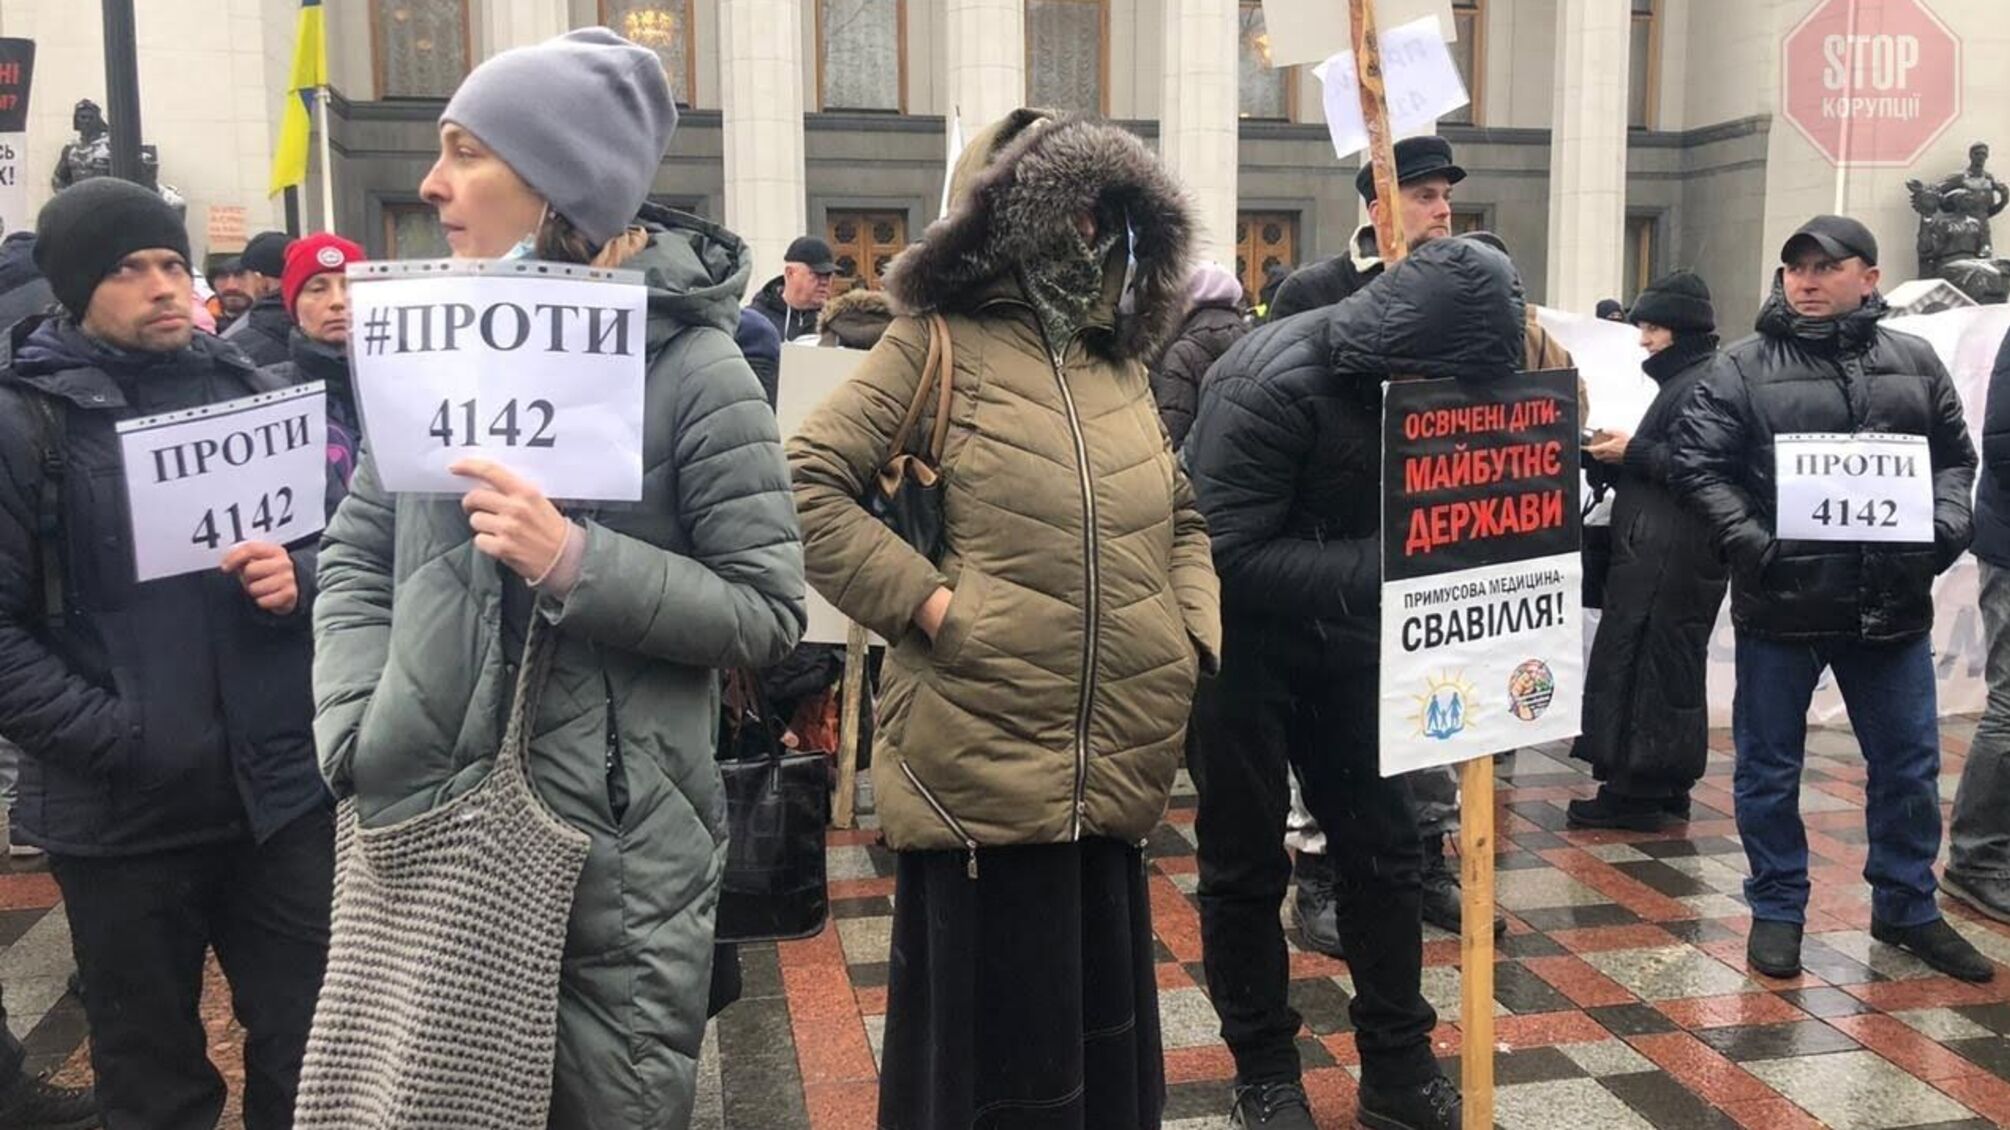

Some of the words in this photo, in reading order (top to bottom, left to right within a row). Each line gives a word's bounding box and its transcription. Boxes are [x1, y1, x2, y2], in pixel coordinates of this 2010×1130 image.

[364, 302, 636, 356] #ПРОТИ
[150, 413, 310, 484] ПРОТИ
[429, 398, 556, 447] 4142
[1405, 403, 1505, 440] ОСВІЧЕНІ
[1405, 440, 1562, 494] МАЙБУТНЄ
[1795, 454, 1917, 477] ПРОТИ
[191, 486, 294, 550] 4142
[1405, 489, 1563, 557] ДЕРЖАВИ
[1811, 498, 1898, 527] 4142
[1401, 592, 1564, 652] СВАВІЛЛЯ!
[1404, 581, 1486, 609] ПРИМУСОВА
